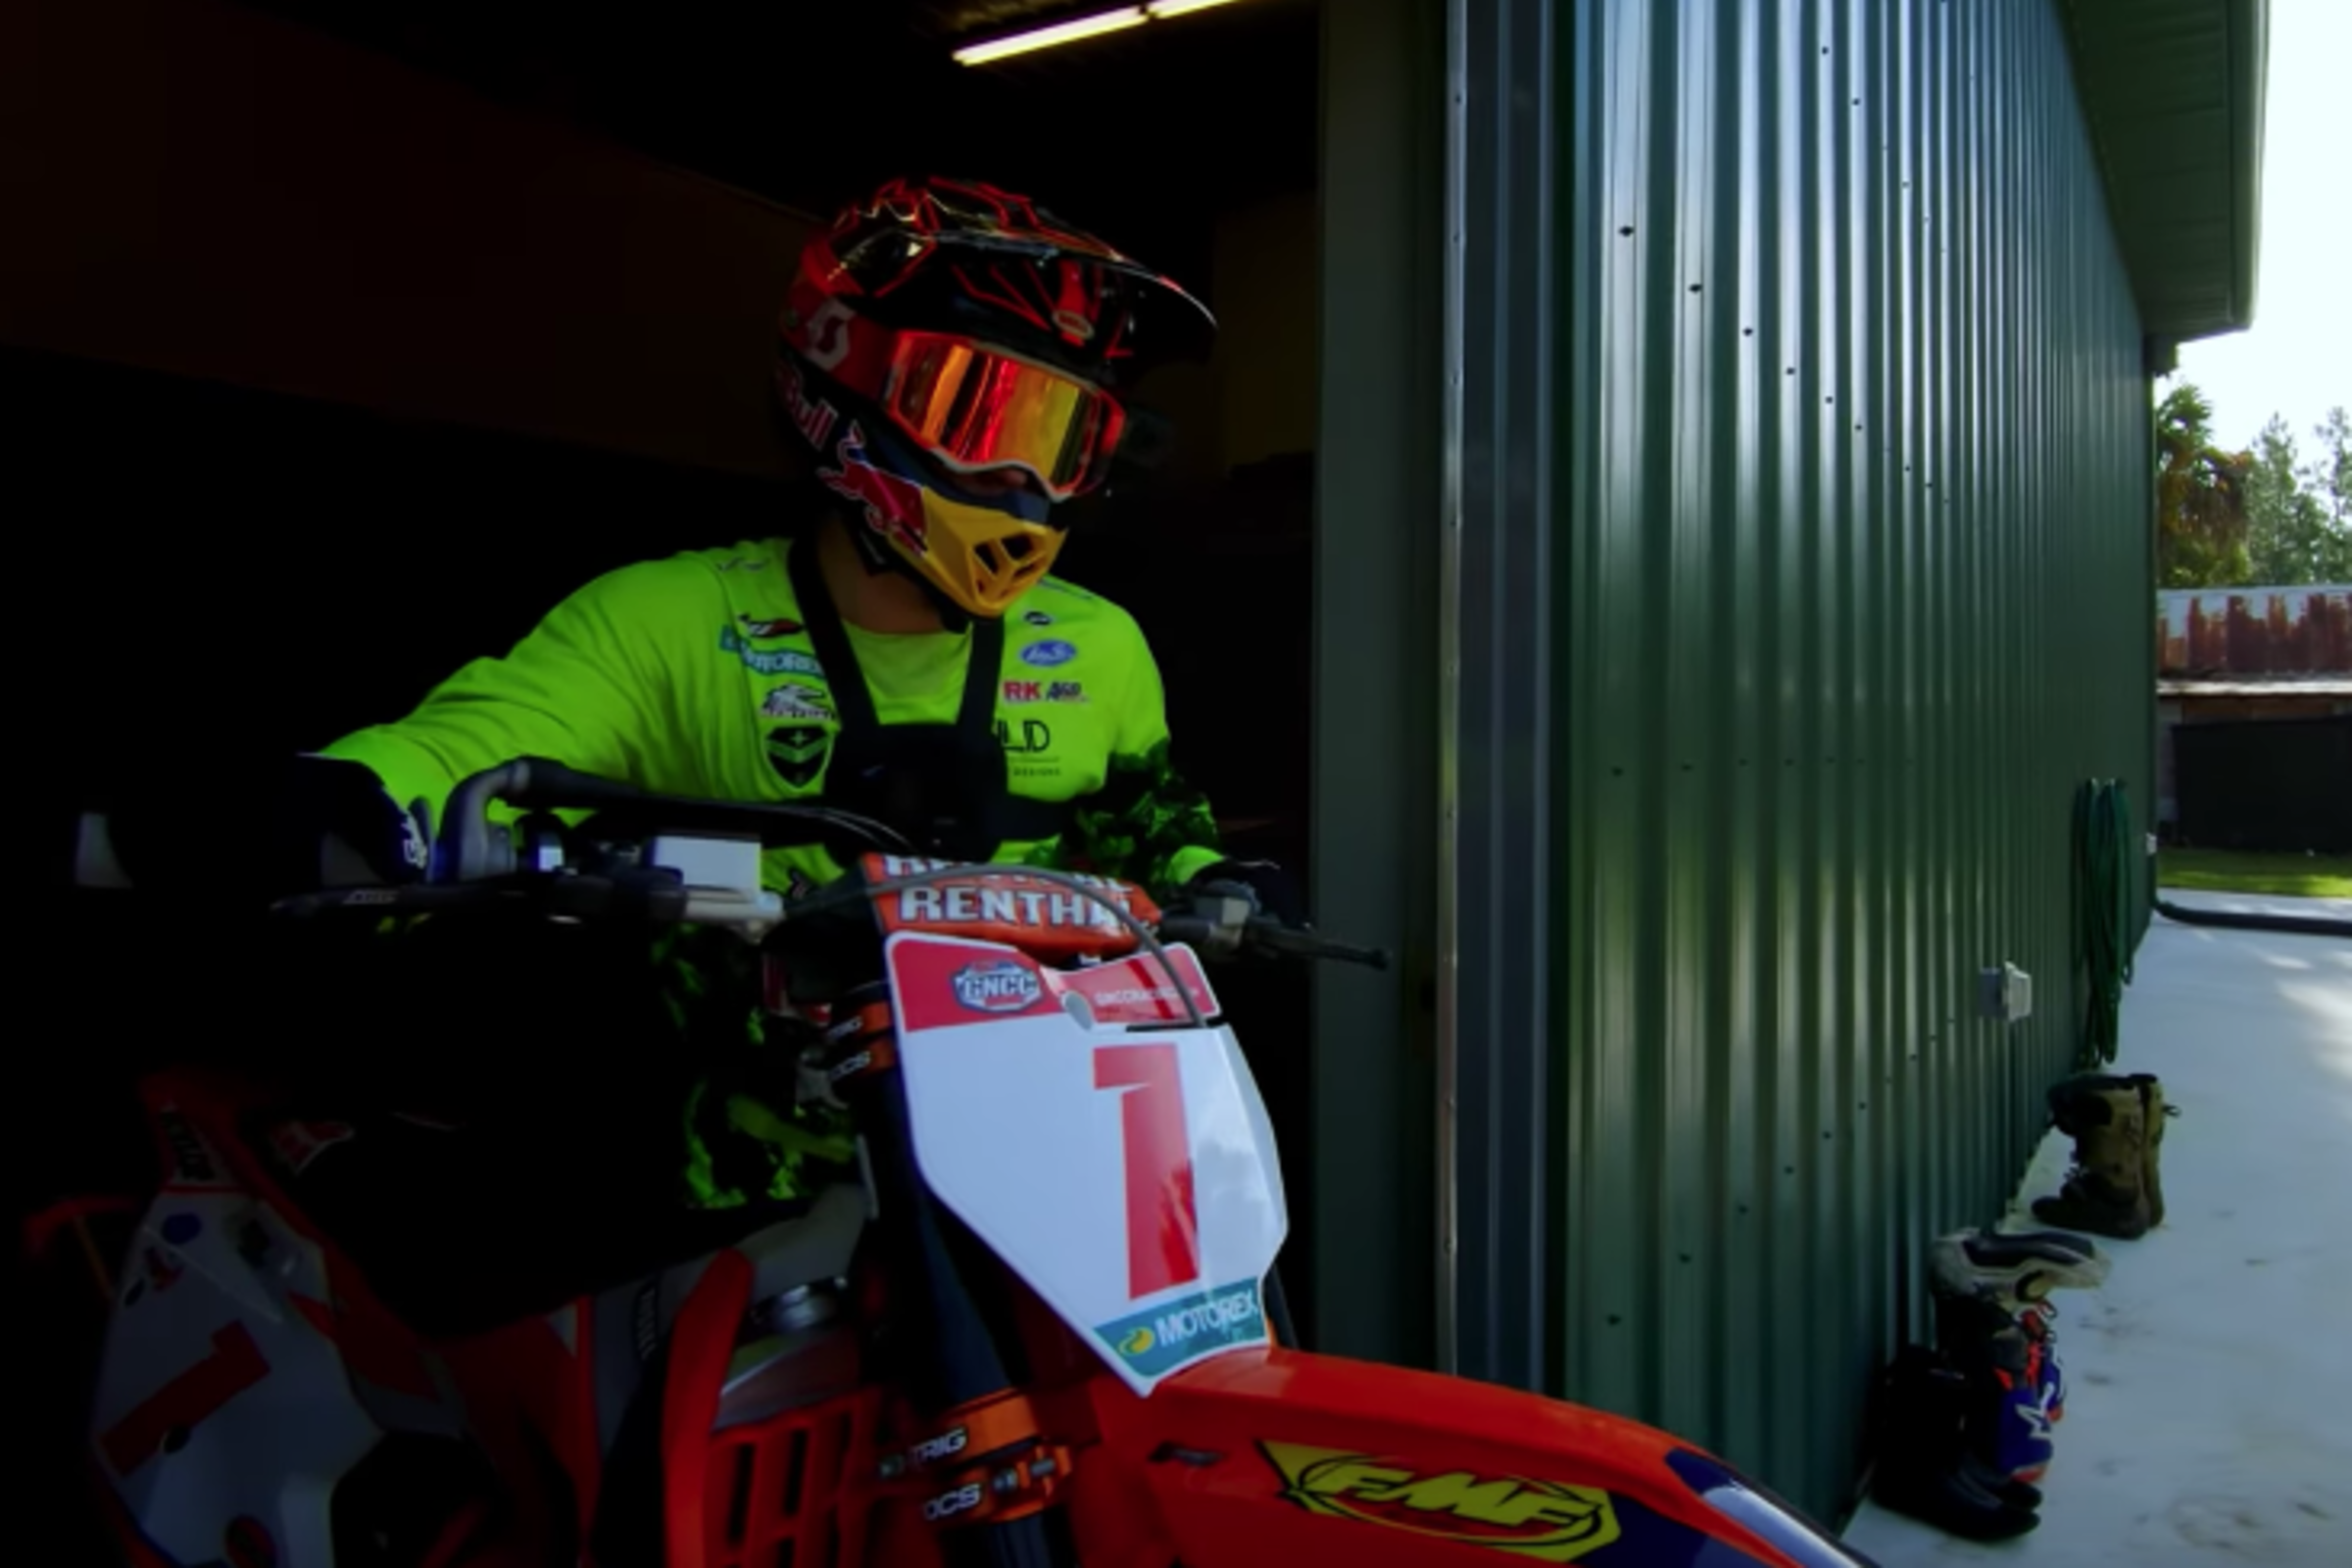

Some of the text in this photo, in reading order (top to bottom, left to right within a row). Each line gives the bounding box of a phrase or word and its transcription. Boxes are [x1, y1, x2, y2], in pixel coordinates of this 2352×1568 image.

[1004, 681, 1040, 701] RK
[1093, 1042, 1200, 1300] 1
[1155, 1288, 1258, 1348] MOTOREX
[1298, 1460, 1601, 1528] FMF
